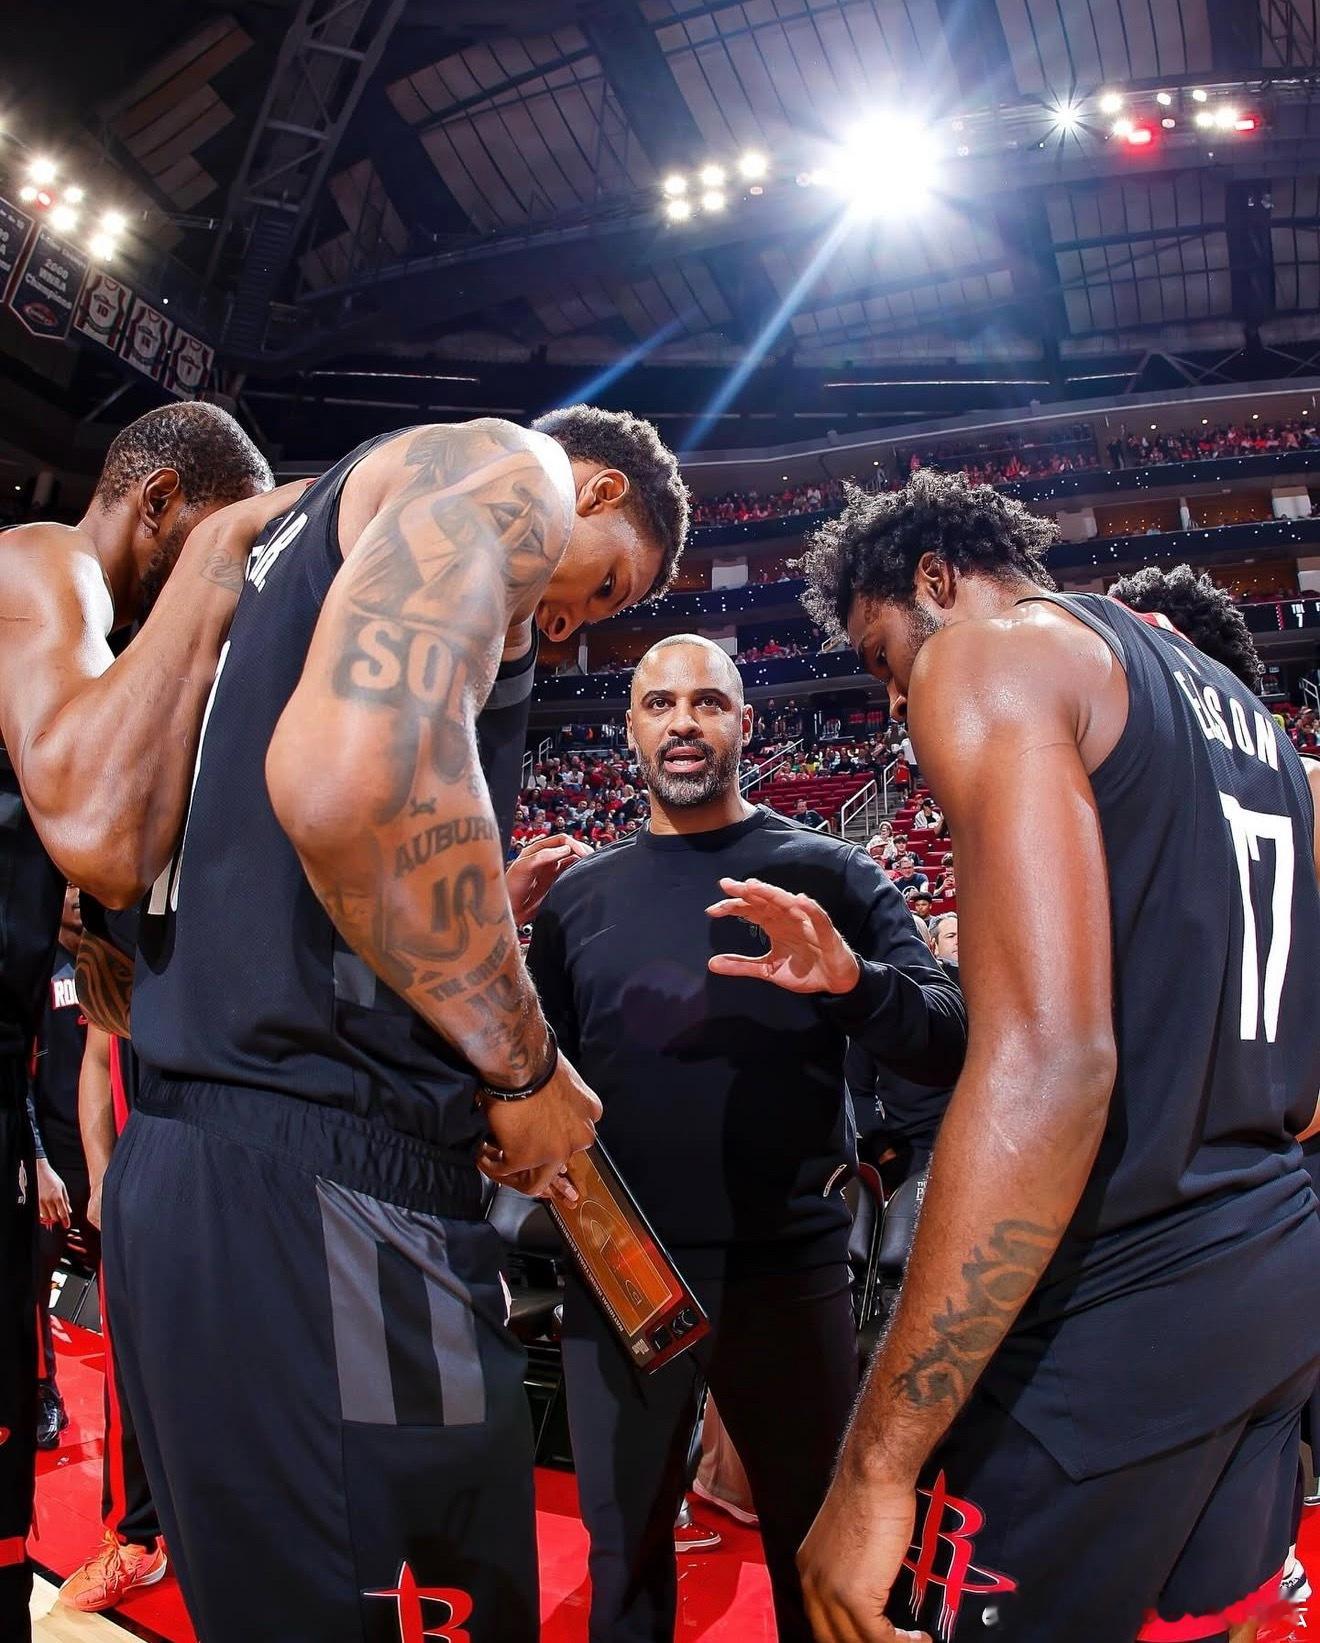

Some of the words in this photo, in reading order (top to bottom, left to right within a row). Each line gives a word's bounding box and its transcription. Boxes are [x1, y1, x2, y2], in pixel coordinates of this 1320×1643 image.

[38, 267, 67, 293] WNBA
[45, 258, 69, 280] 2000
[25, 273, 73, 310] Champions
[1296, 614, 1303, 628] 7
[1219, 791, 1294, 1044] 17
